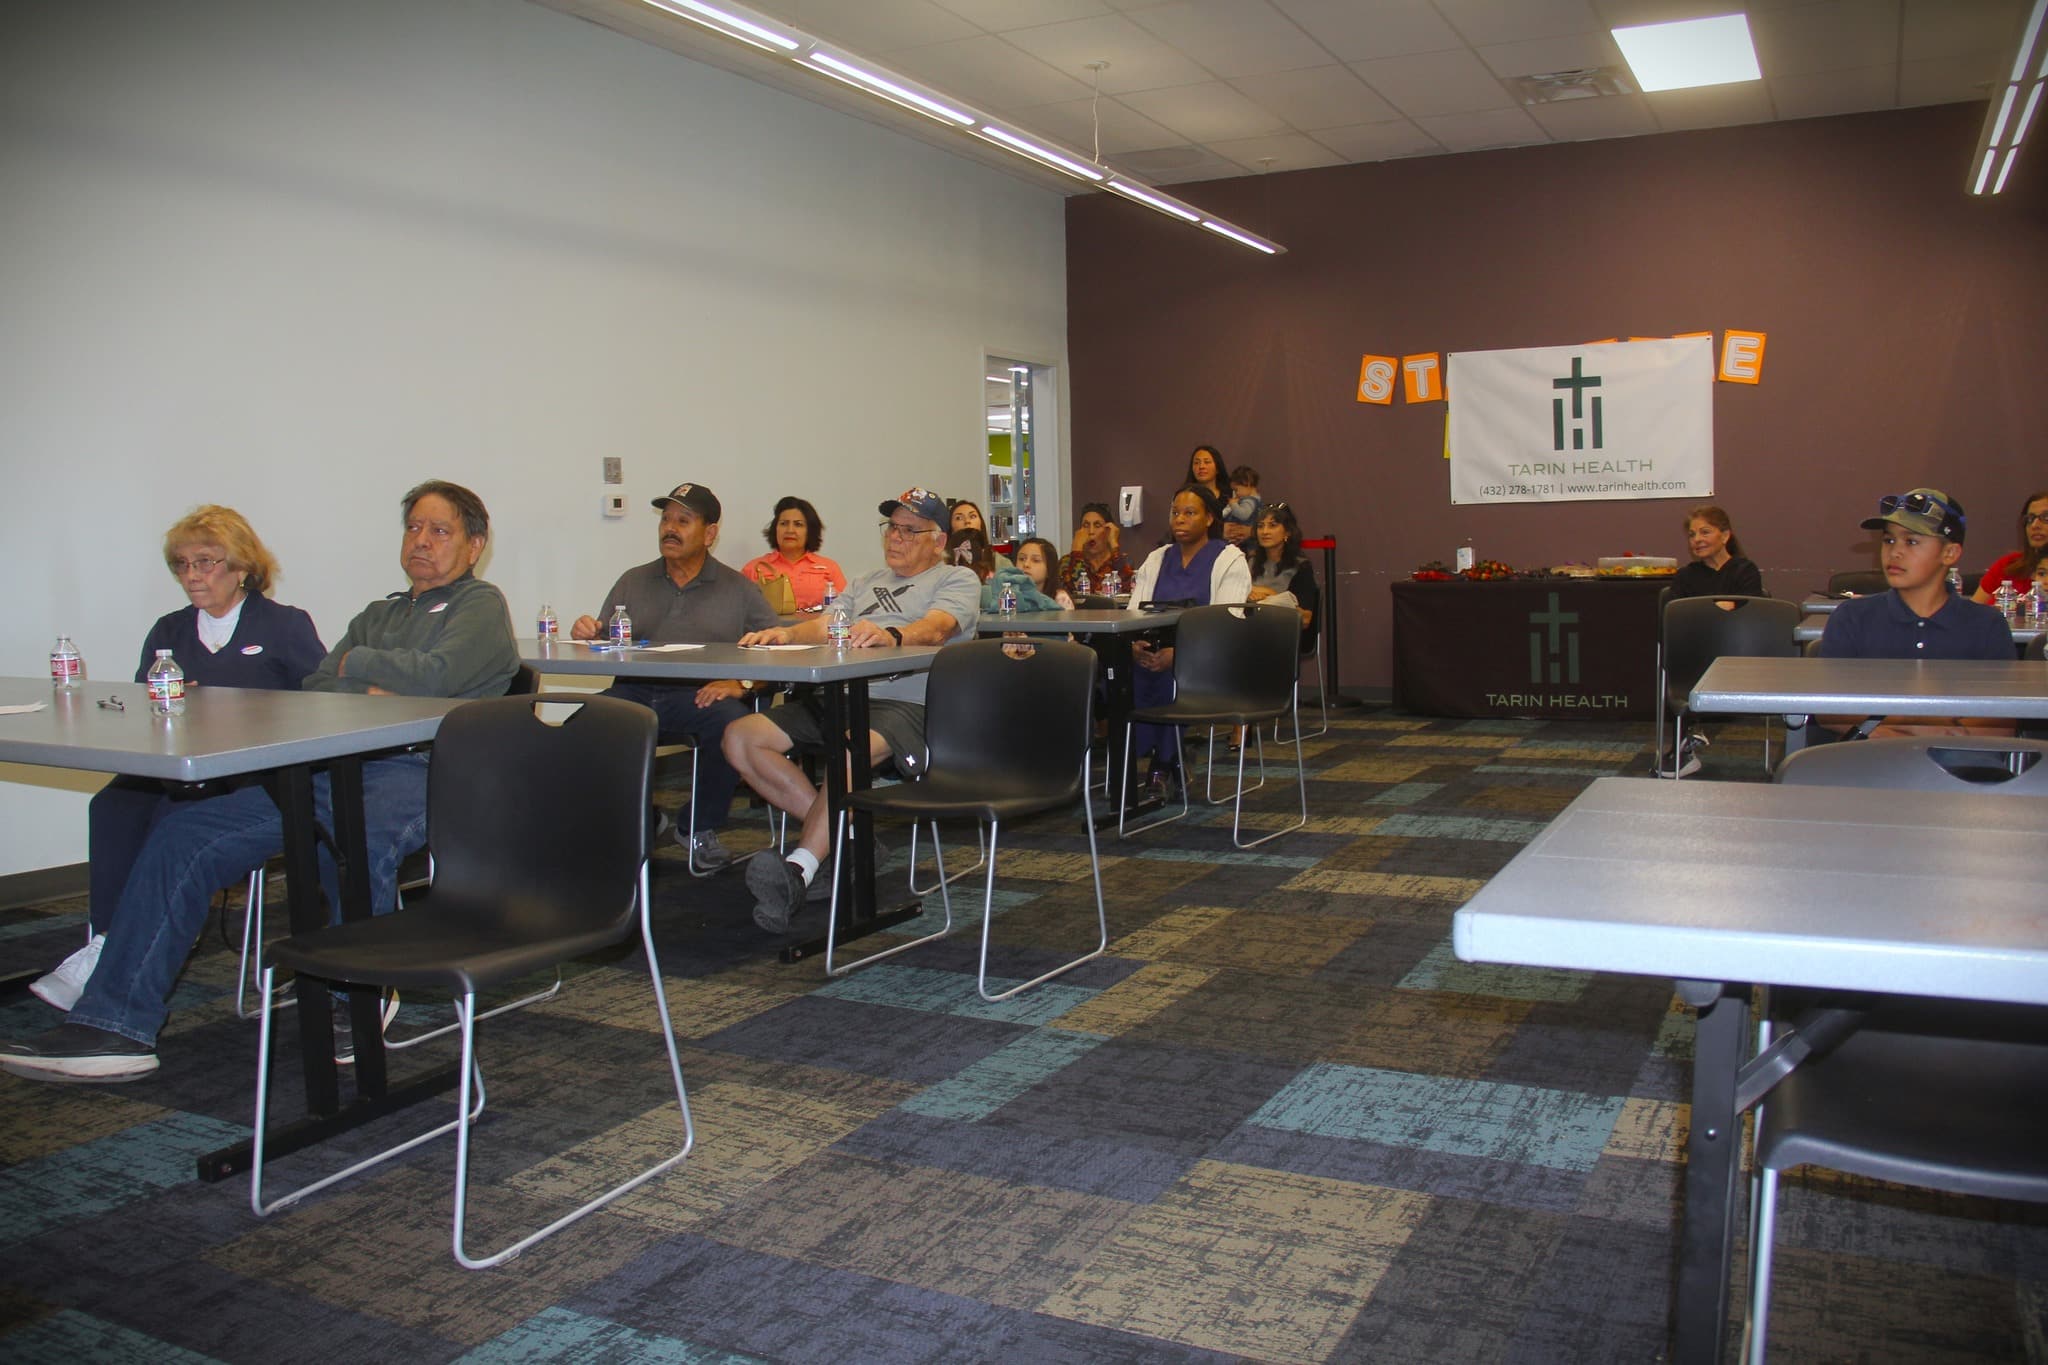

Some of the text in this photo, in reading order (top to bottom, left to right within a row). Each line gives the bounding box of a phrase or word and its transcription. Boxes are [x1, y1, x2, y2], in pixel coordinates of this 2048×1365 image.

[1508, 459, 1653, 476] TARIN HEALTH
[1479, 485, 1506, 497] (432)
[1509, 484, 1554, 495] 278-1781
[1567, 479, 1686, 494] www.tarinhealth.com
[1486, 694, 1628, 708] TARIN HEALTH
